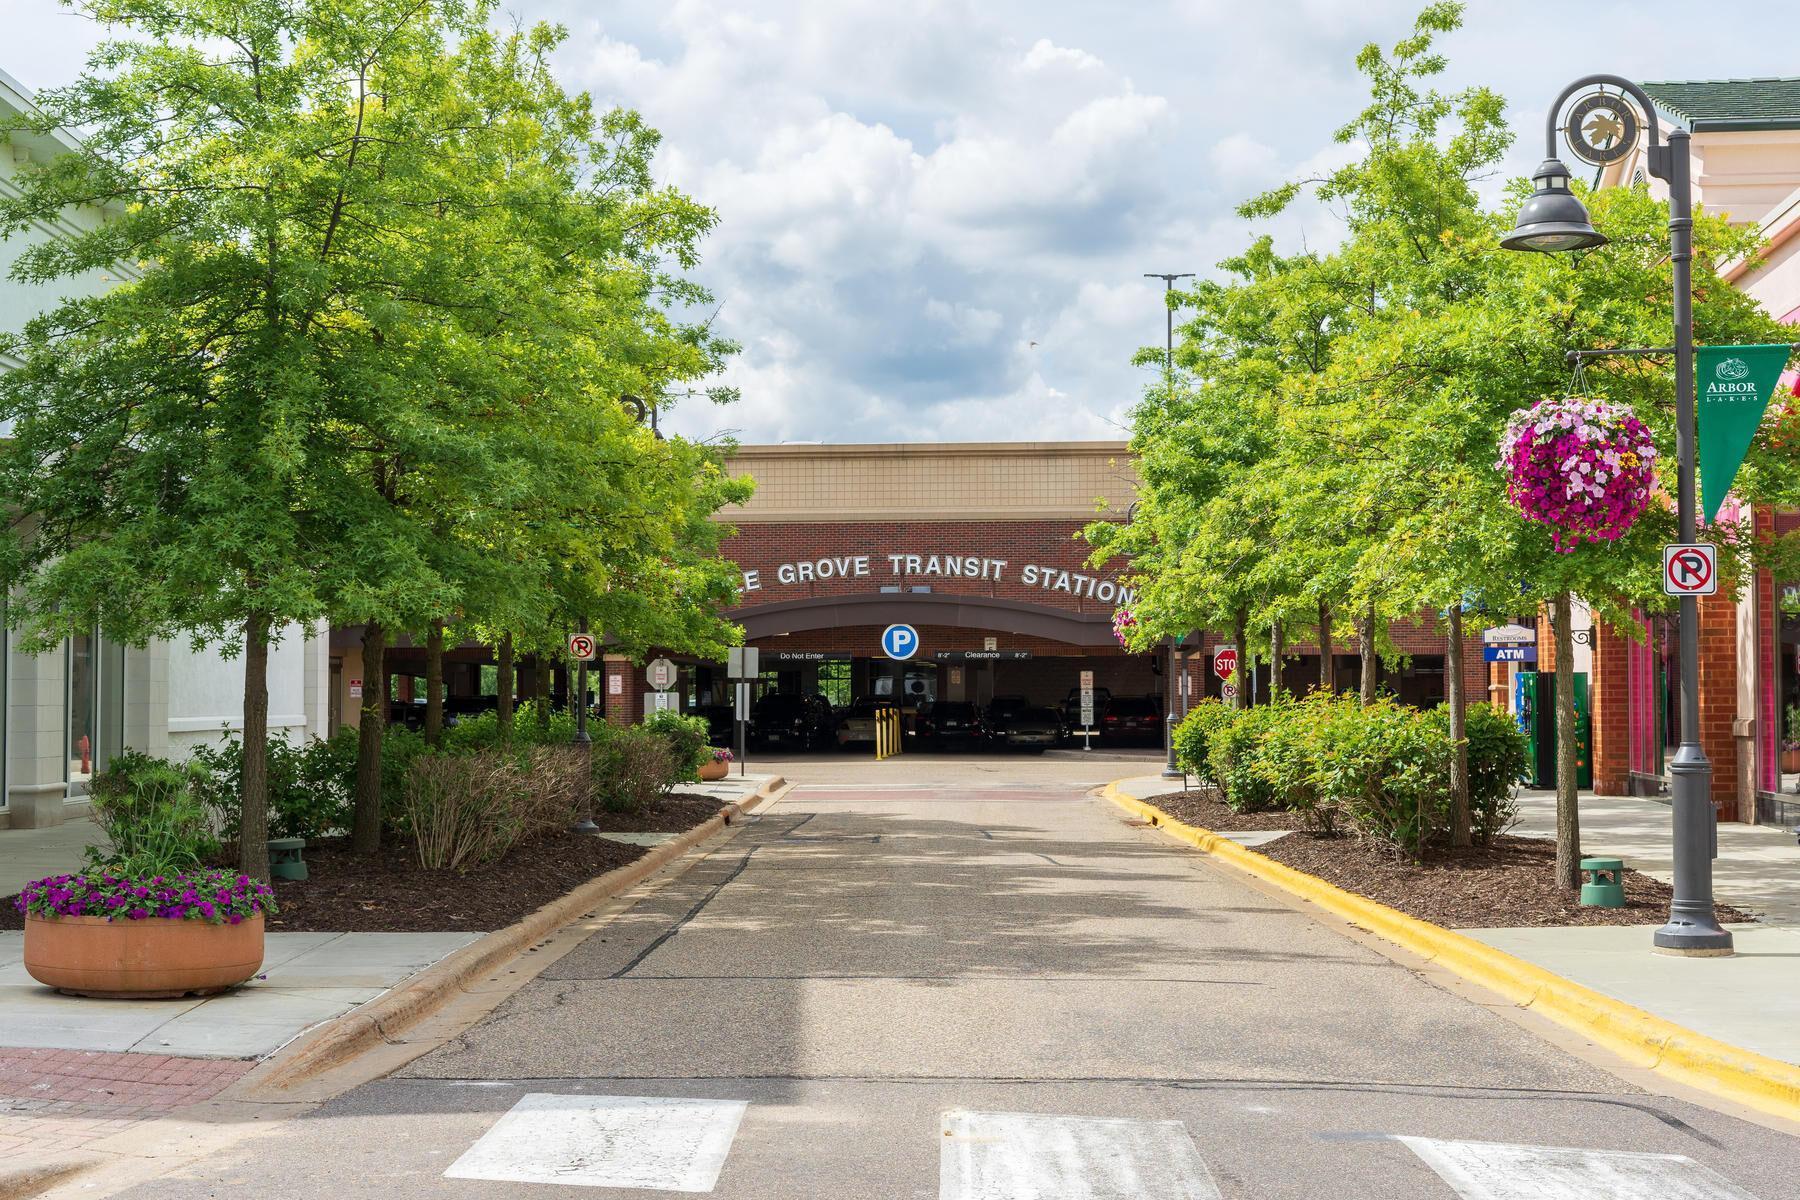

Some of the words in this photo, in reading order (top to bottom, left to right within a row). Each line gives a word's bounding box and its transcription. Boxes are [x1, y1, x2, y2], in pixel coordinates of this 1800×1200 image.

[1706, 381, 1757, 393] ARBOR
[778, 556, 870, 585] GROVE
[888, 555, 1007, 581] TRANSIT
[1022, 564, 1135, 606] STATION
[893, 630, 912, 653] P
[780, 652, 791, 660] Do
[792, 652, 804, 660] Not
[805, 652, 825, 660] Enter
[964, 651, 1001, 659] Clearance
[1496, 649, 1524, 660] ATM
[1216, 658, 1237, 671] STO
